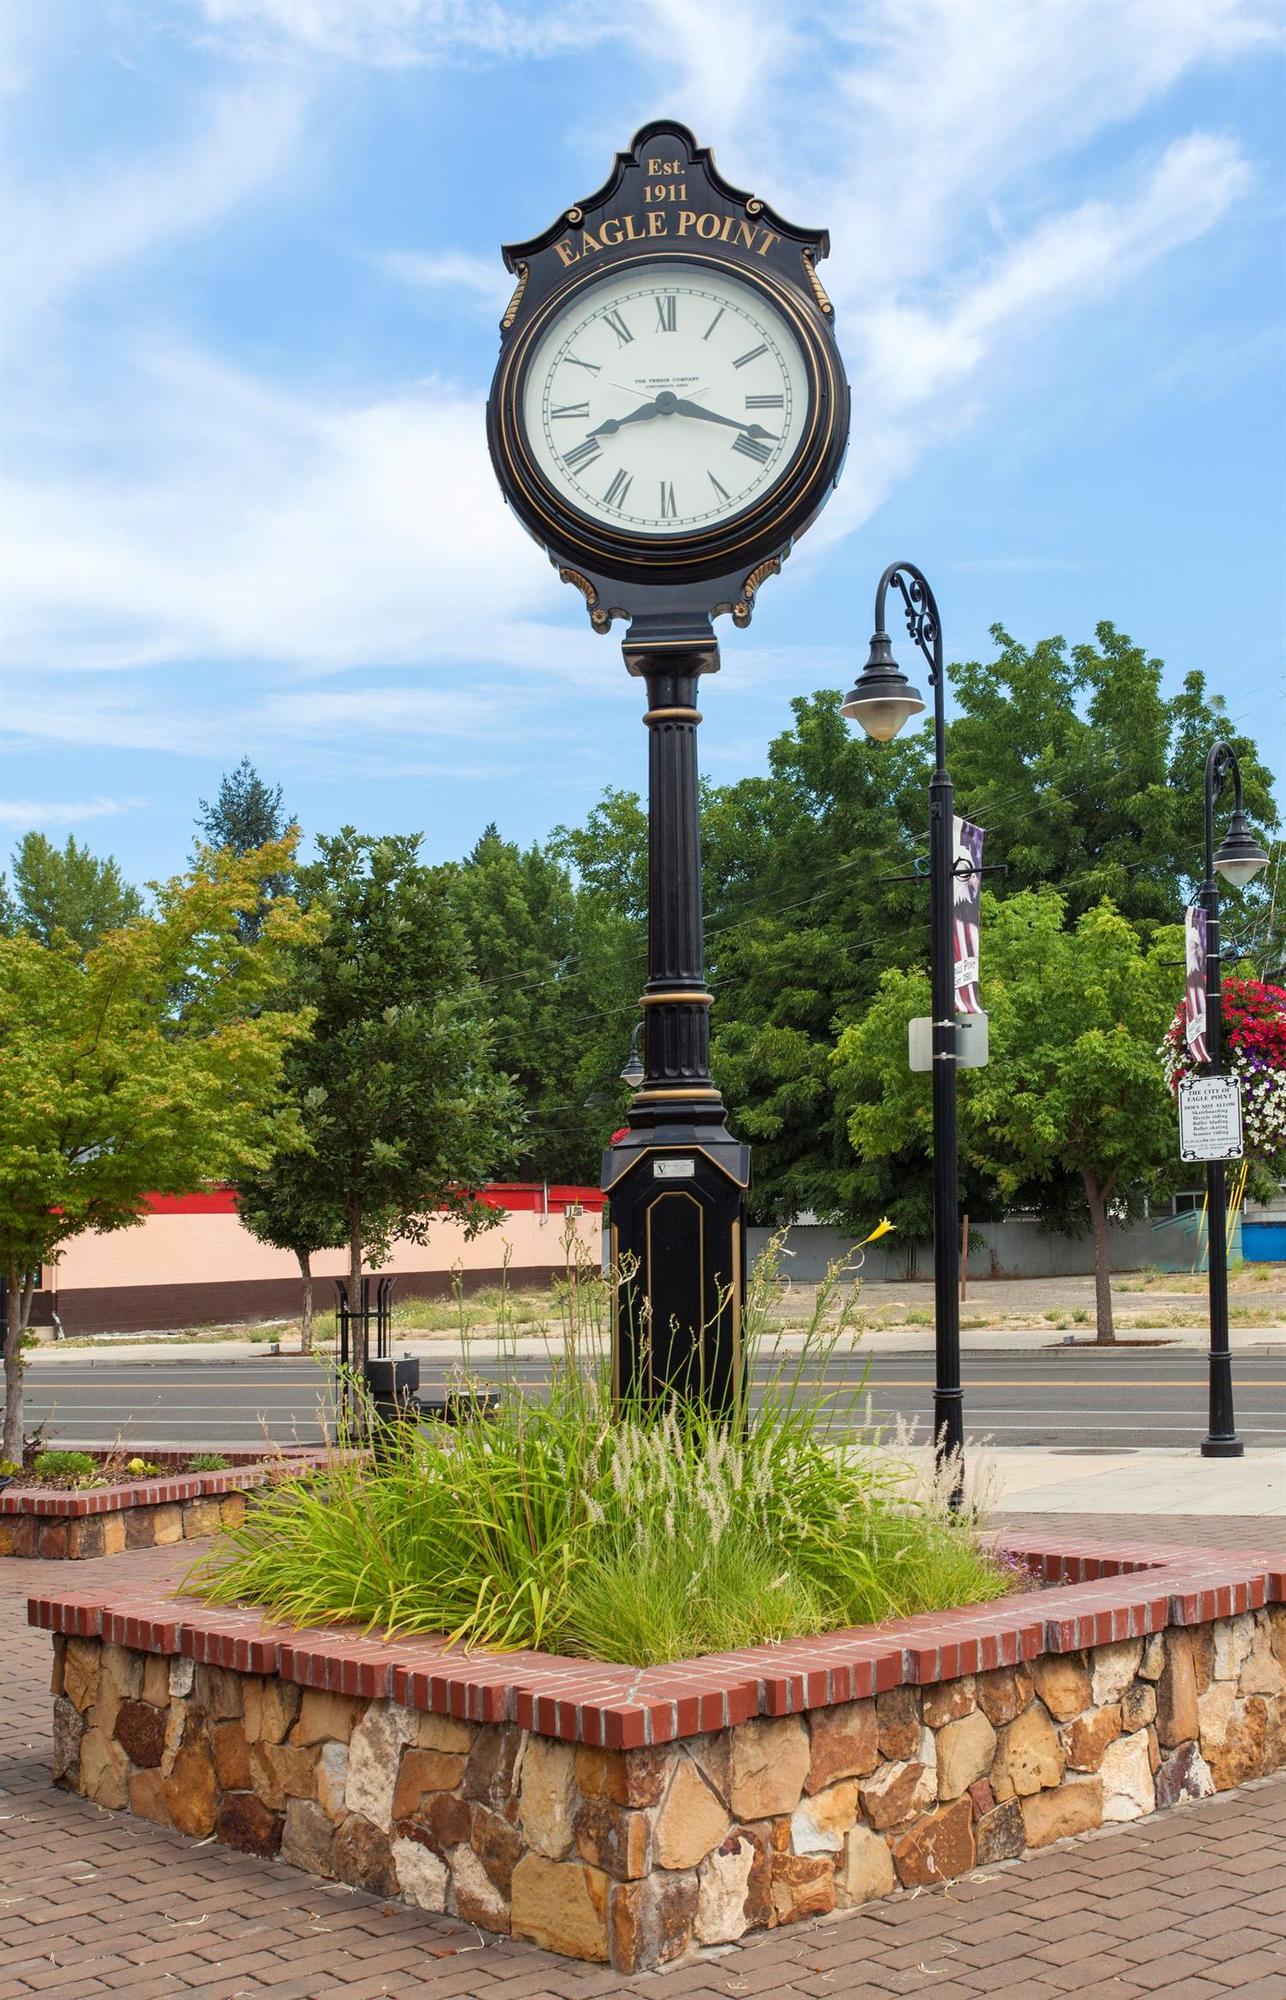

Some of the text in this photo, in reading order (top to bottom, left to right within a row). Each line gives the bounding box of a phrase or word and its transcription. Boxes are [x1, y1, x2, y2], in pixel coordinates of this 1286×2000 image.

[647, 158, 685, 177] Est.
[643, 183, 688, 203] 1911
[552, 210, 782, 268] EAGLE POINT
[601, 308, 635, 349] XI
[655, 295, 677, 333] XII
[702, 307, 726, 341] I
[563, 350, 603, 378] X
[732, 343, 769, 370] II
[551, 400, 590, 420] IX
[745, 394, 784, 409] III
[602, 468, 635, 510] VII
[659, 481, 678, 519] VI
[706, 469, 731, 505] V
